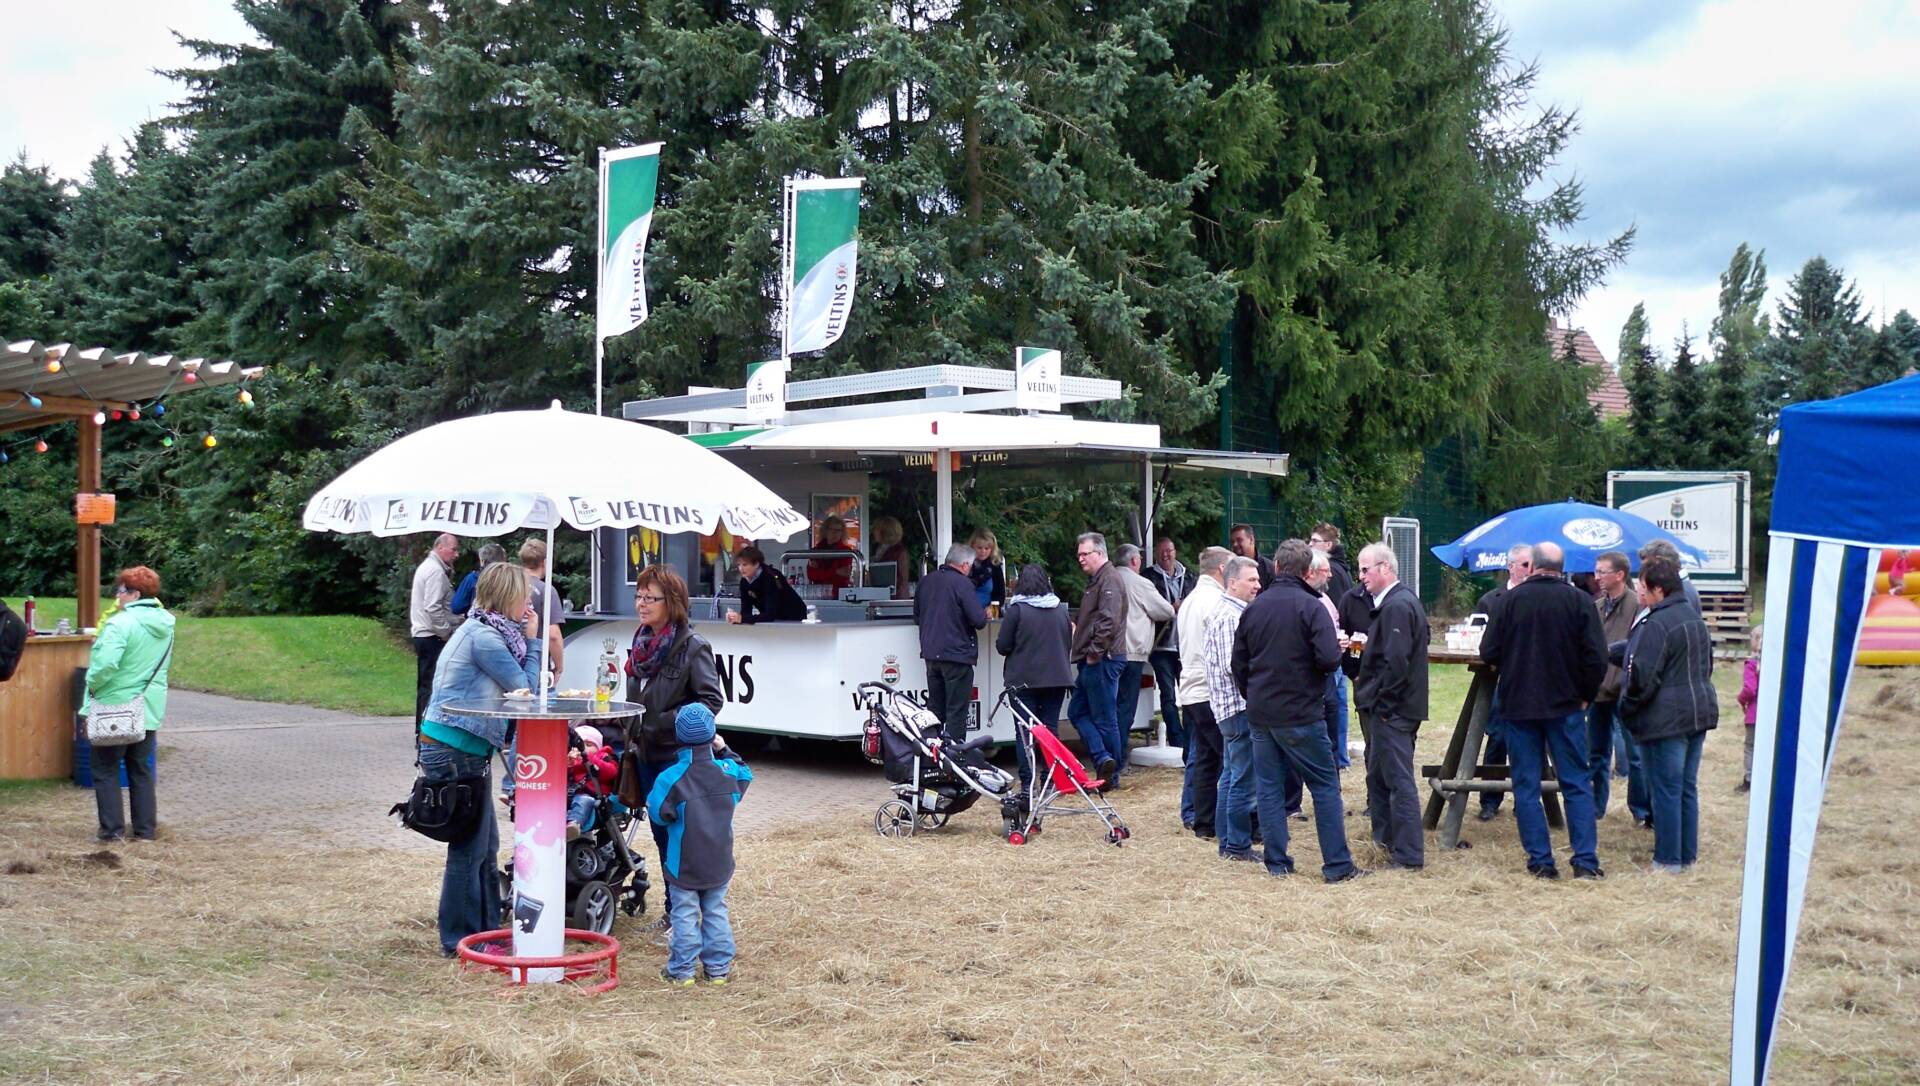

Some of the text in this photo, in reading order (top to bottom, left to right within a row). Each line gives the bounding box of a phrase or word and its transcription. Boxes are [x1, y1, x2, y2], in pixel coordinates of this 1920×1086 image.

[826, 283, 848, 339] VELTINS
[1027, 382, 1057, 393] VELTINS
[904, 453, 934, 466] VELTIN
[421, 500, 511, 525] VELTINS
[607, 501, 703, 525] VELTINS
[1657, 519, 1699, 530] VELTINS
